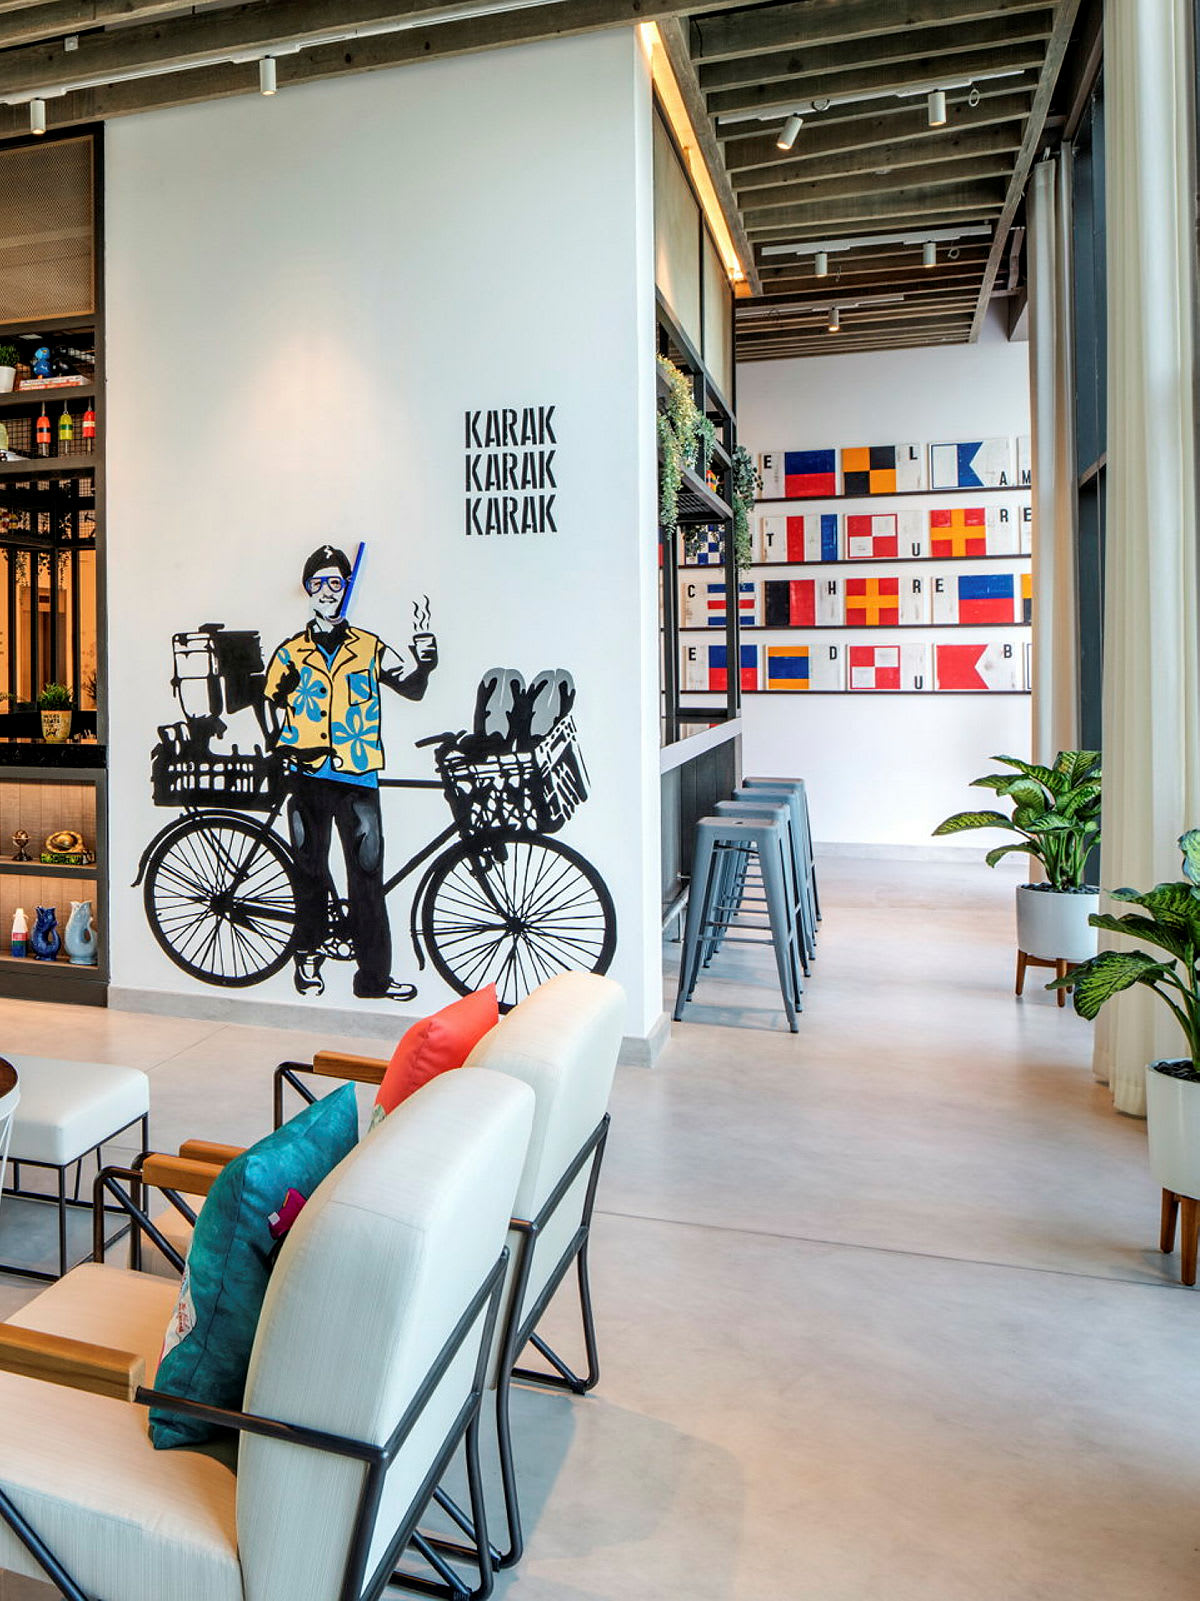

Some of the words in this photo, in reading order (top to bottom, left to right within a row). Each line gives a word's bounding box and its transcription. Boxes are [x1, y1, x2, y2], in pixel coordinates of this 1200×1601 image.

[465, 405, 557, 449] KARAK
[465, 449, 557, 493] KARAK
[763, 454, 773, 470] E
[909, 446, 918, 461] L
[999, 471, 1008, 486] A
[465, 493, 558, 537] KARAK
[765, 532, 775, 547] T
[911, 542, 921, 558] U
[1000, 508, 1009, 523] R
[1023, 507, 1031, 522] E
[687, 584, 696, 599] C
[827, 580, 837, 595] H
[912, 579, 921, 594] R
[935, 578, 944, 593] E
[688, 647, 697, 661] E
[829, 645, 838, 661] D
[914, 675, 924, 690] U
[1003, 644, 1012, 659] B
